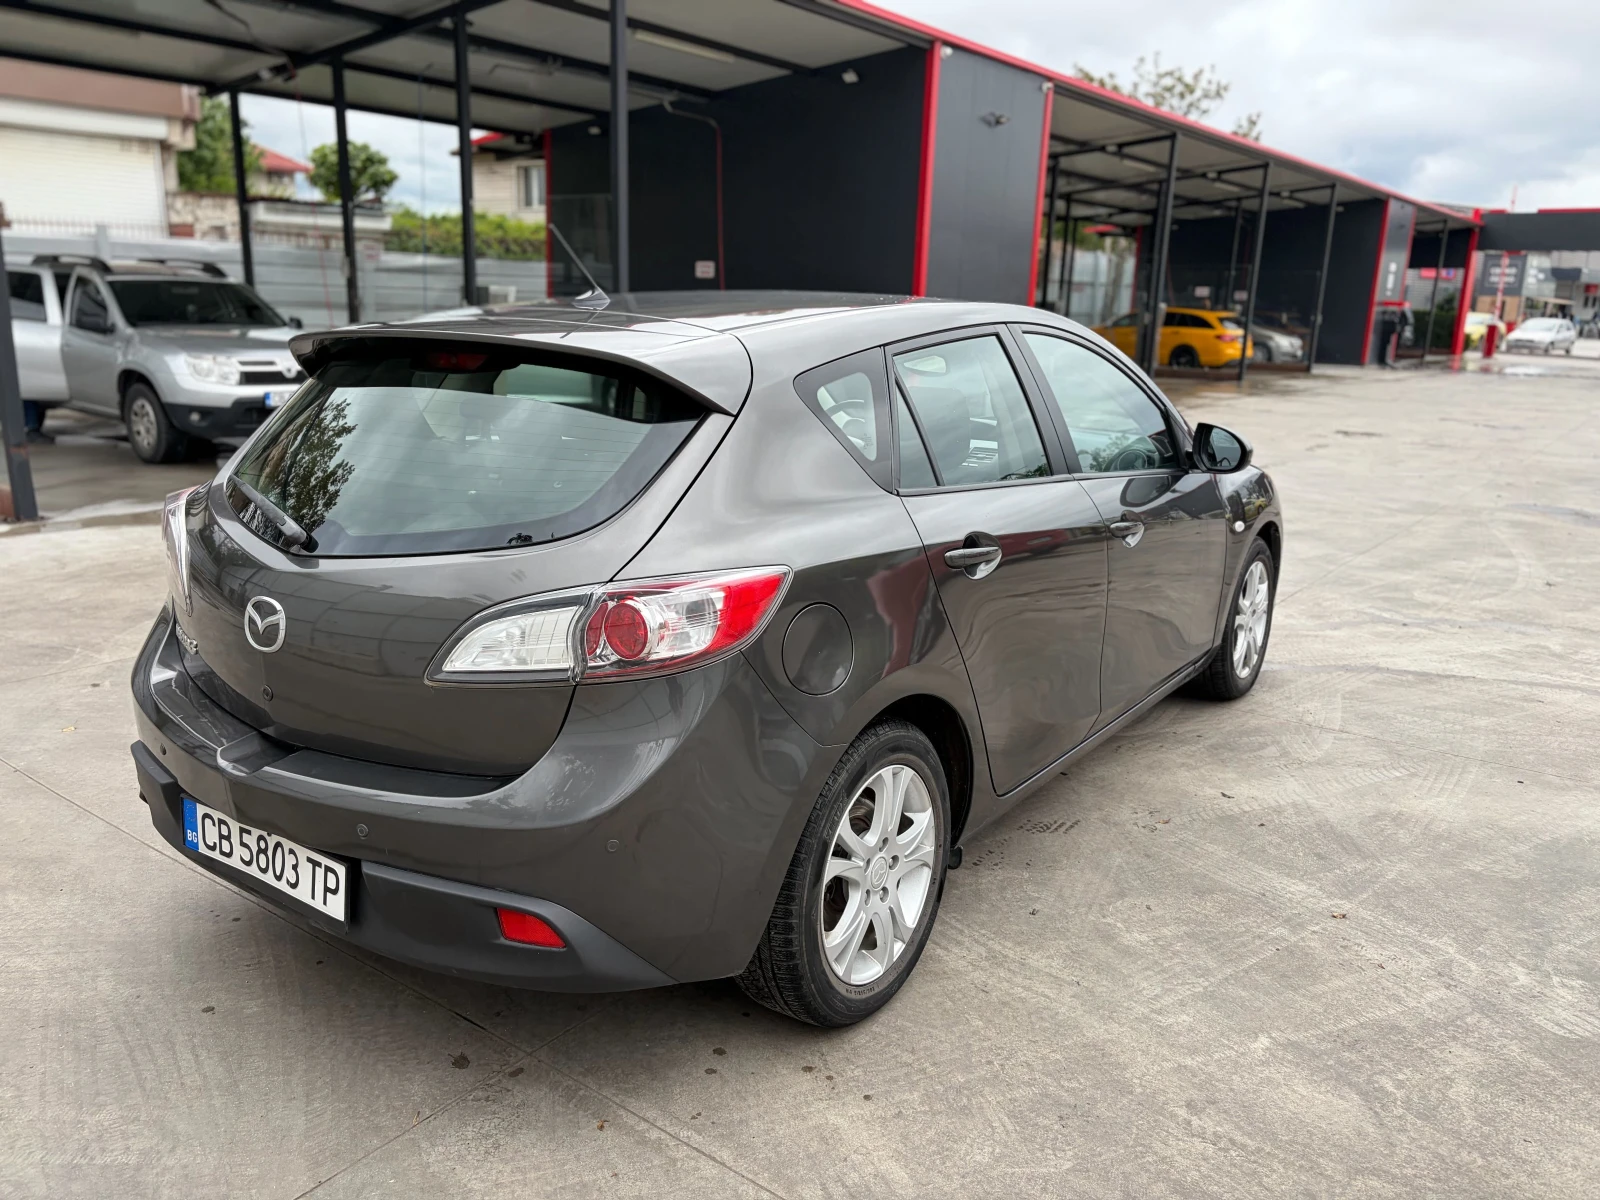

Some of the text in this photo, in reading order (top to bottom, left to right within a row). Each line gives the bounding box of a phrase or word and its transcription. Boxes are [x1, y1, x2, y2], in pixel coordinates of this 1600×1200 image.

[187, 829, 198, 843] BG
[201, 812, 340, 907] CB 5803 TP
